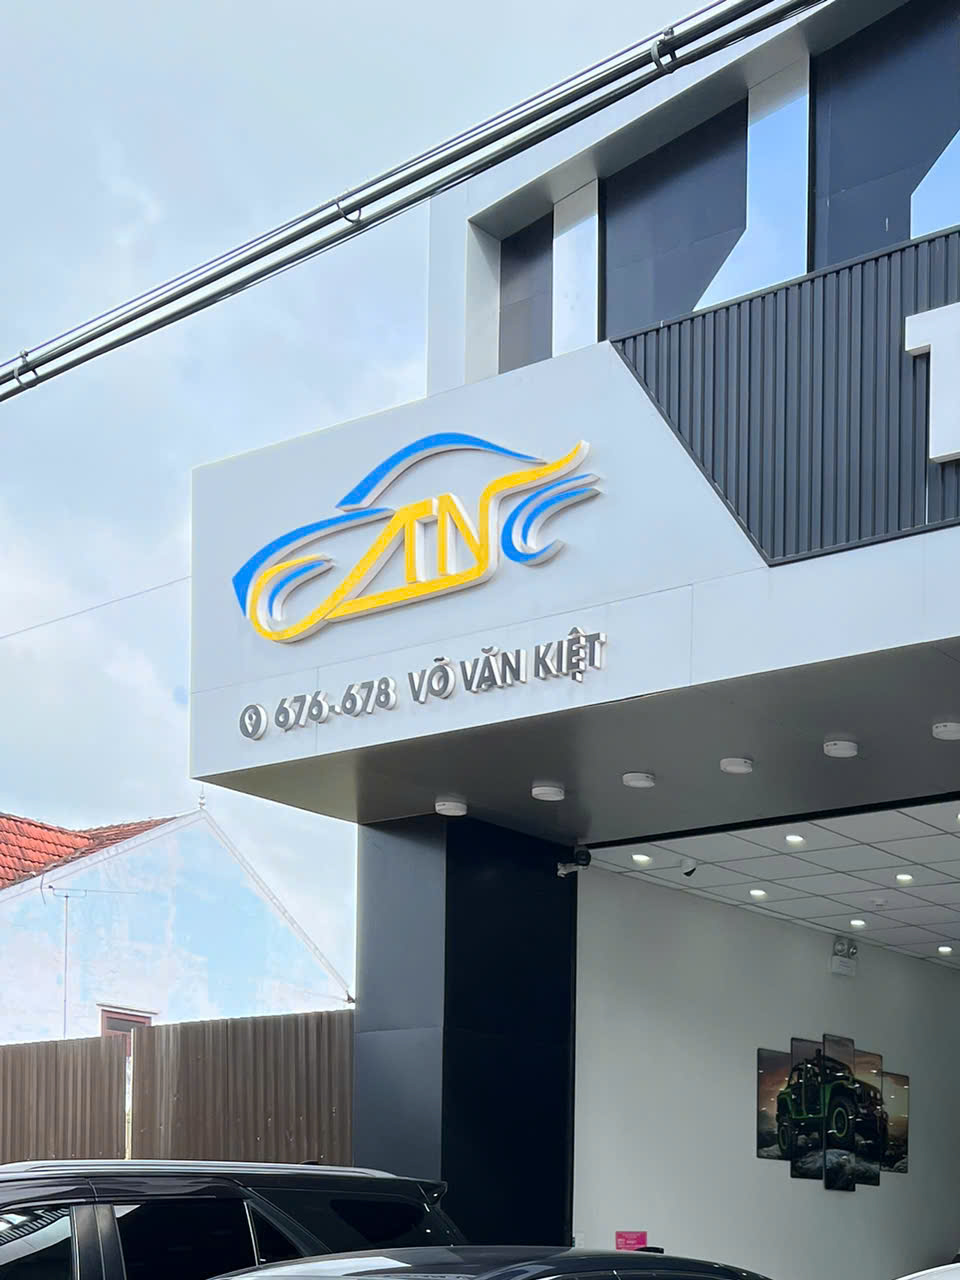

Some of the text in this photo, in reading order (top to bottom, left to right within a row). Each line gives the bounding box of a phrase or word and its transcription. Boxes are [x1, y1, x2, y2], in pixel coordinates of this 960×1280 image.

[408, 656, 455, 703] VÕ
[460, 645, 527, 693] VĂN
[534, 626, 607, 682] KIỆT
